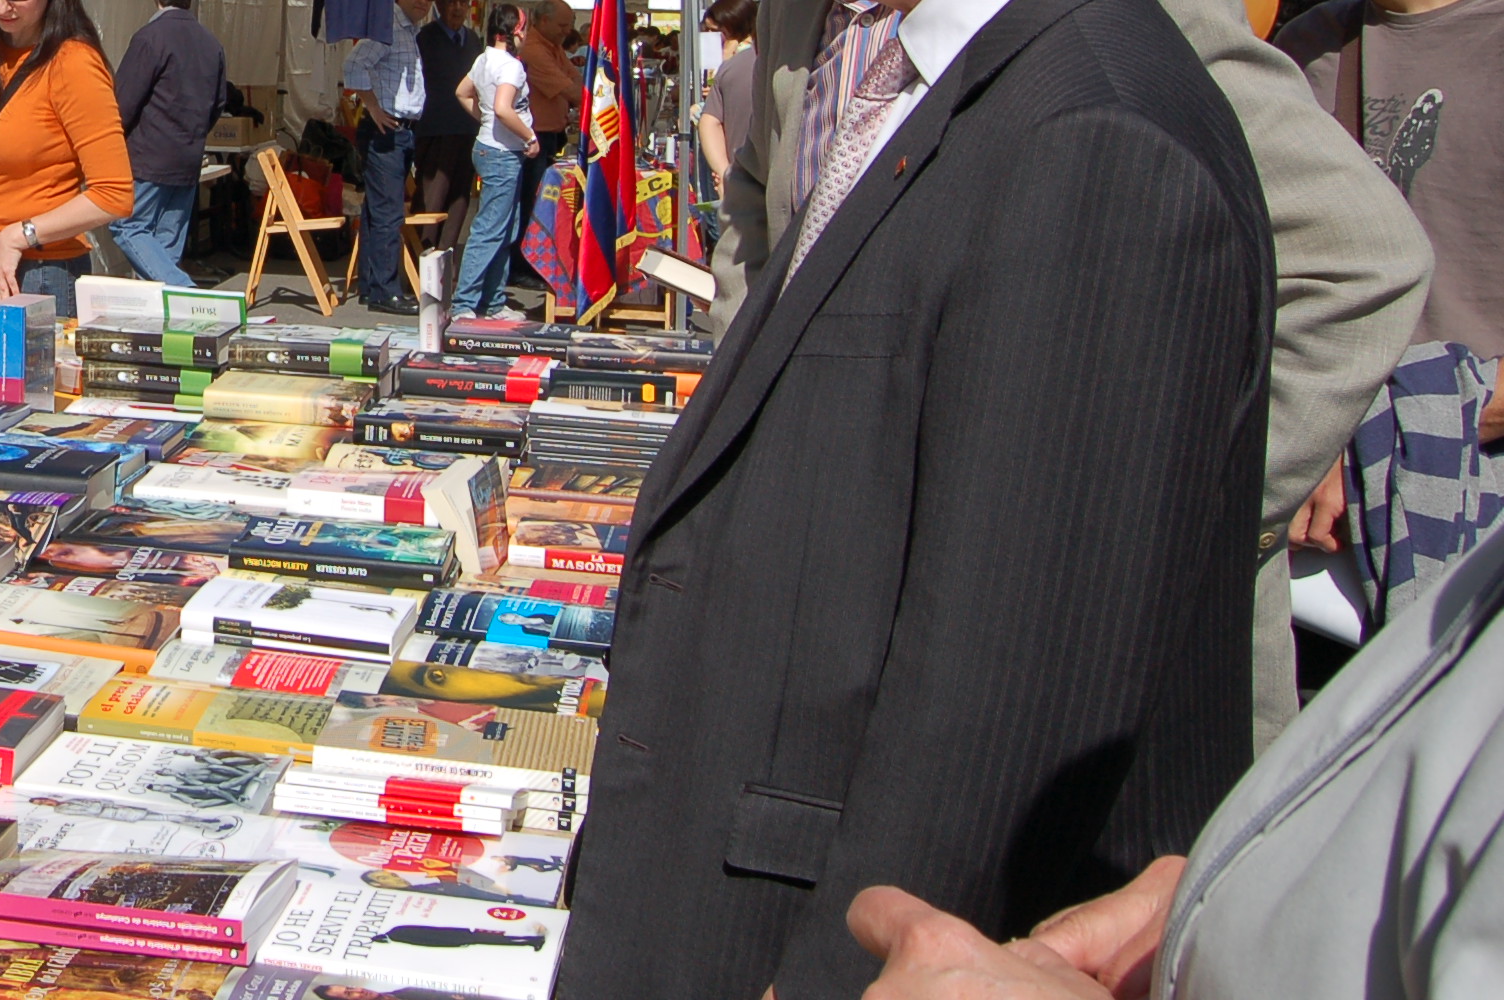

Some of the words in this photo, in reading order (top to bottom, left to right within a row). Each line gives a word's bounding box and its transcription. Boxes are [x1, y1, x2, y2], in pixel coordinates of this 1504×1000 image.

[191, 305, 217, 318] ping
[590, 554, 604, 563] LA
[59, 741, 123, 787] FOT-LI,
[271, 927, 303, 951] JO
[287, 908, 314, 929] HE
[307, 904, 352, 956] SERVIT
[340, 888, 363, 905] EL
[343, 890, 397, 960] TRIPARTIT
